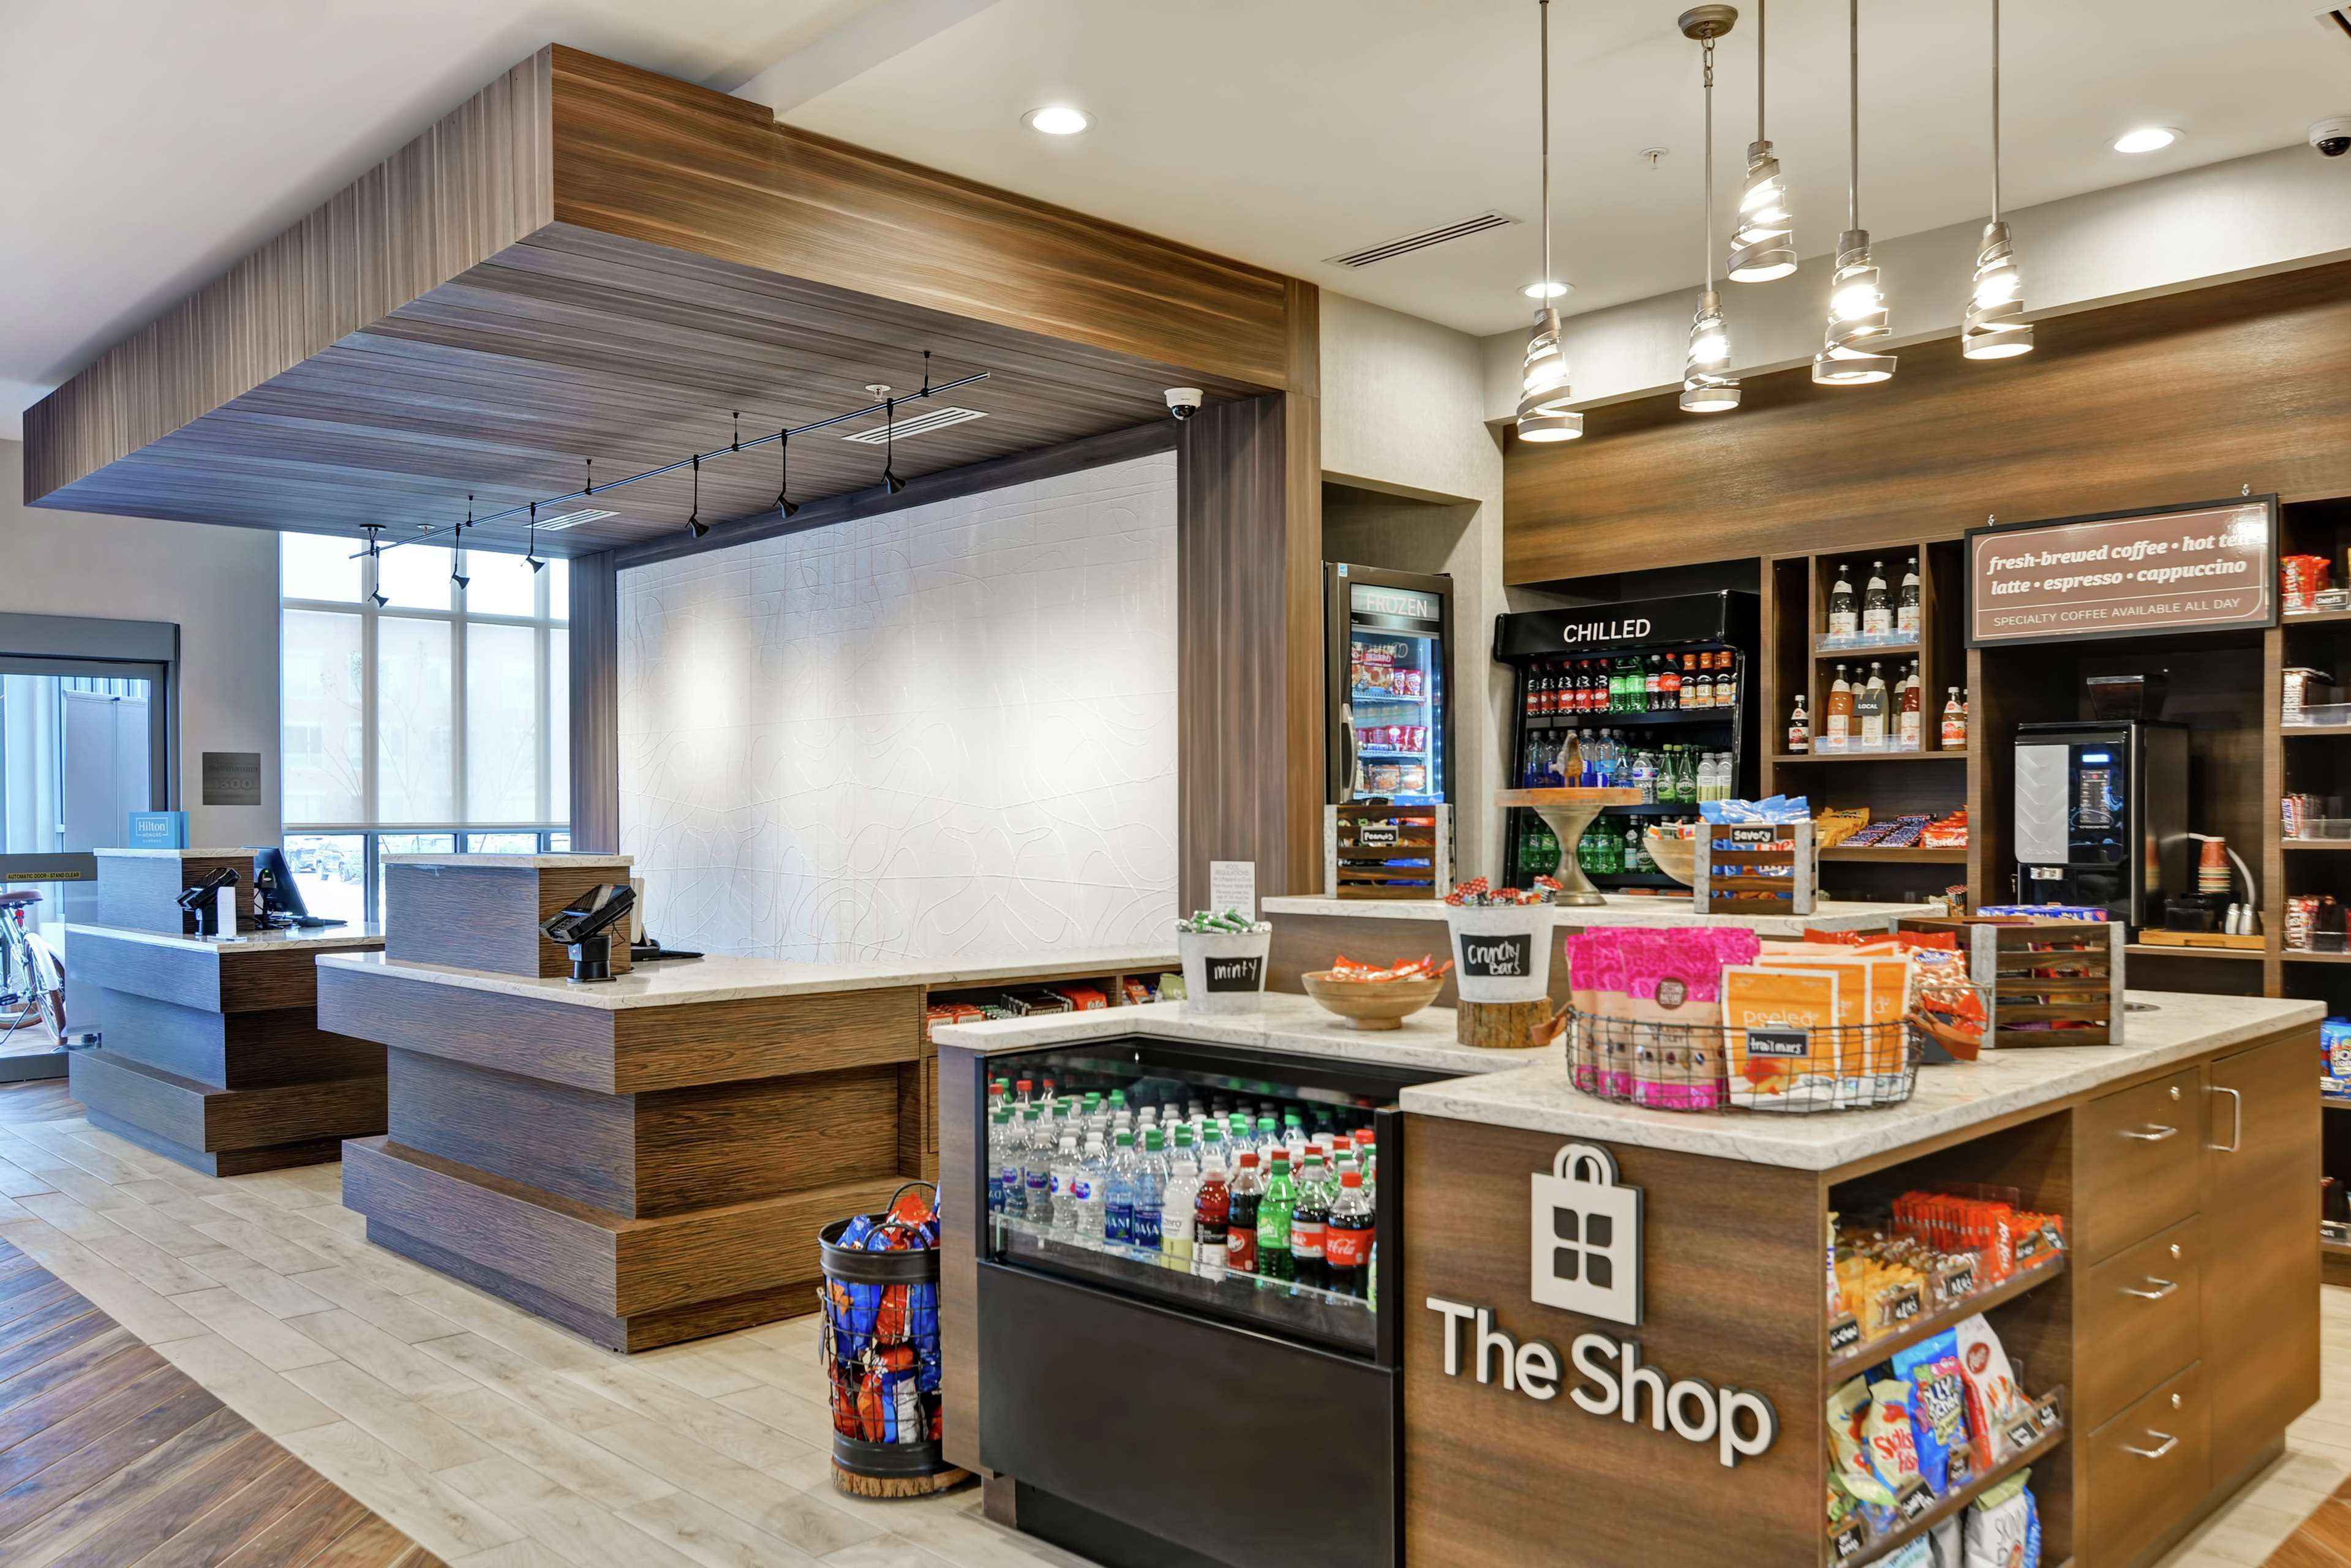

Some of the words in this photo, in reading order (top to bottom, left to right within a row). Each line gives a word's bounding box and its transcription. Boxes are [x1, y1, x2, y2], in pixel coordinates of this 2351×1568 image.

[1986, 545, 2108, 575] fresh-brewed
[2111, 540, 2168, 561] coffee
[2182, 535, 2216, 552] hot
[1992, 580, 2031, 595] latte
[2044, 572, 2123, 592] espresso
[2137, 558, 2247, 583] cappuccino
[1366, 594, 1427, 617] FROZEN
[1993, 613, 2057, 627] SPECIALTY
[2061, 609, 2107, 621] COFFEE
[2112, 602, 2181, 617] AVAILABLE
[2184, 601, 2210, 612] ALL
[2214, 598, 2241, 610] DAY
[1563, 619, 1650, 642] CHILLED
[138, 821, 165, 831] Hilton
[1734, 830, 1772, 842] Savory
[1468, 940, 1520, 966] Crunchy
[1214, 959, 1257, 981] minty
[1489, 962, 1521, 975] Bars
[1426, 1295, 1562, 1400] The
[1570, 1332, 1778, 1468] Shop
